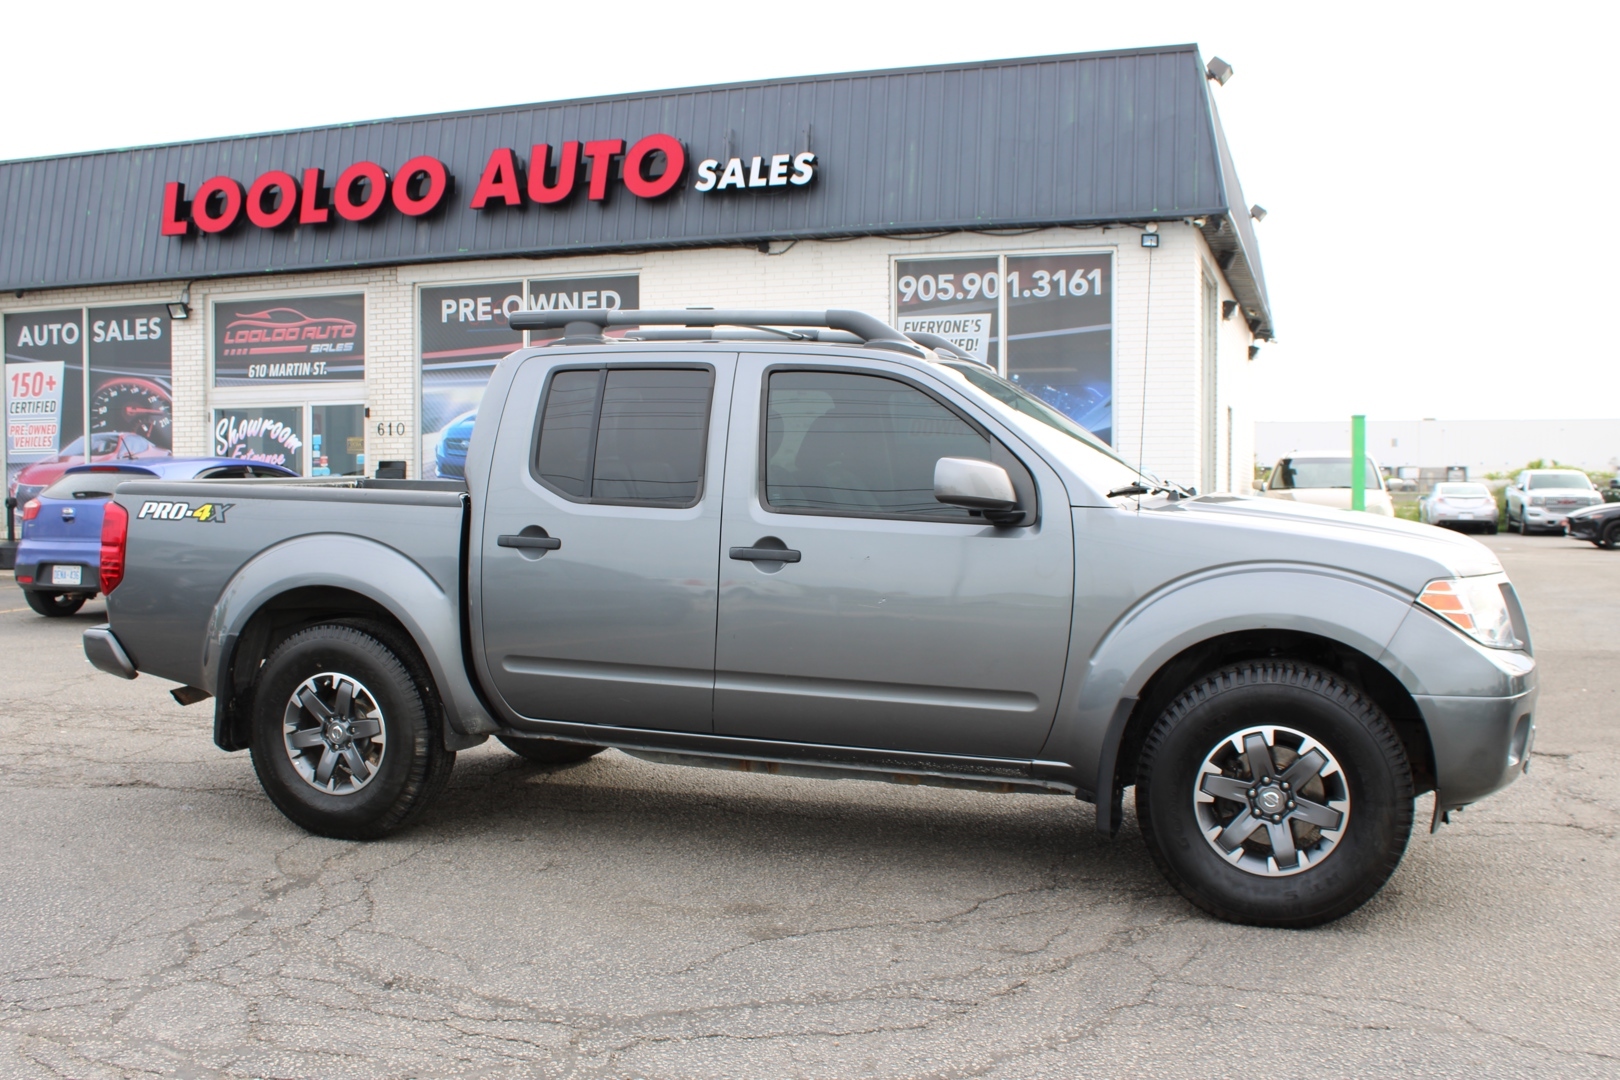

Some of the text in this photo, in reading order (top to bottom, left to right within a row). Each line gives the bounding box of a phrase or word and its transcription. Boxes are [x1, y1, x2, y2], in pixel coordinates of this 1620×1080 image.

[161, 132, 818, 237] LOOLOO AUTO SALES
[898, 268, 1102, 302] 905.901.3161
[441, 289, 622, 323] PRE-OWNED
[17, 317, 162, 347] AUTO SALES
[223, 324, 357, 344] LOOLOO AUTO
[903, 318, 982, 333] EVERYONE'S
[310, 342, 354, 353] SALES
[248, 361, 327, 378] 610 MARTIN ST.
[11, 371, 57, 398] 150+
[9, 400, 57, 414] CERTIFIED
[10, 424, 57, 435] PRE-OWNED
[215, 415, 303, 455] Showroom
[377, 422, 405, 436] 610
[14, 436, 53, 447] VEHICLES
[136, 500, 236, 523] PRO-4X
